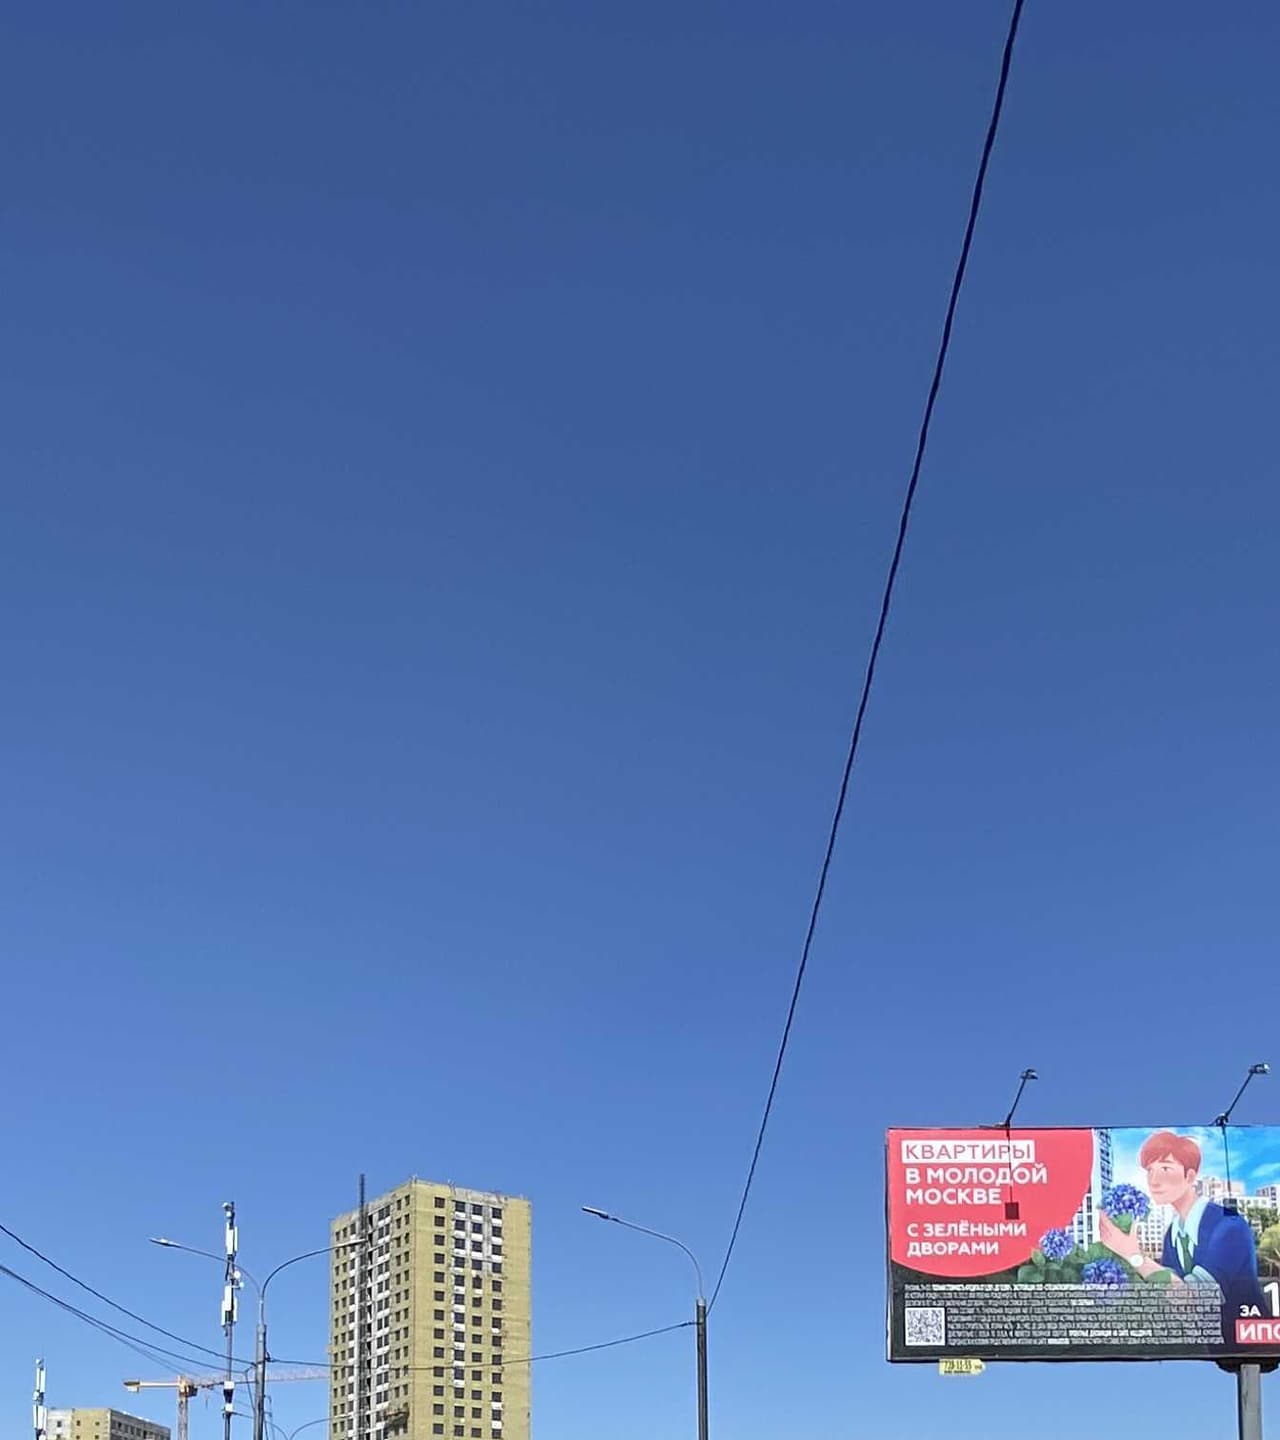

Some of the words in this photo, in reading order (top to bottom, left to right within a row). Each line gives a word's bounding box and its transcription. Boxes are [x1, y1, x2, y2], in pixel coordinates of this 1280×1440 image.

[905, 1143, 1032, 1160] КВАРТИРЫ
[905, 1167, 921, 1184] В
[926, 1162, 1048, 1187] МОЛОДОЙ
[905, 1187, 1002, 1205] МОСКВЕ
[906, 1223, 919, 1237] С
[923, 1219, 1027, 1237] ЗЕЛЁНЫМИ
[906, 1241, 1000, 1258] ДВОРАМИ
[1239, 1304, 1262, 1317] ЗА
